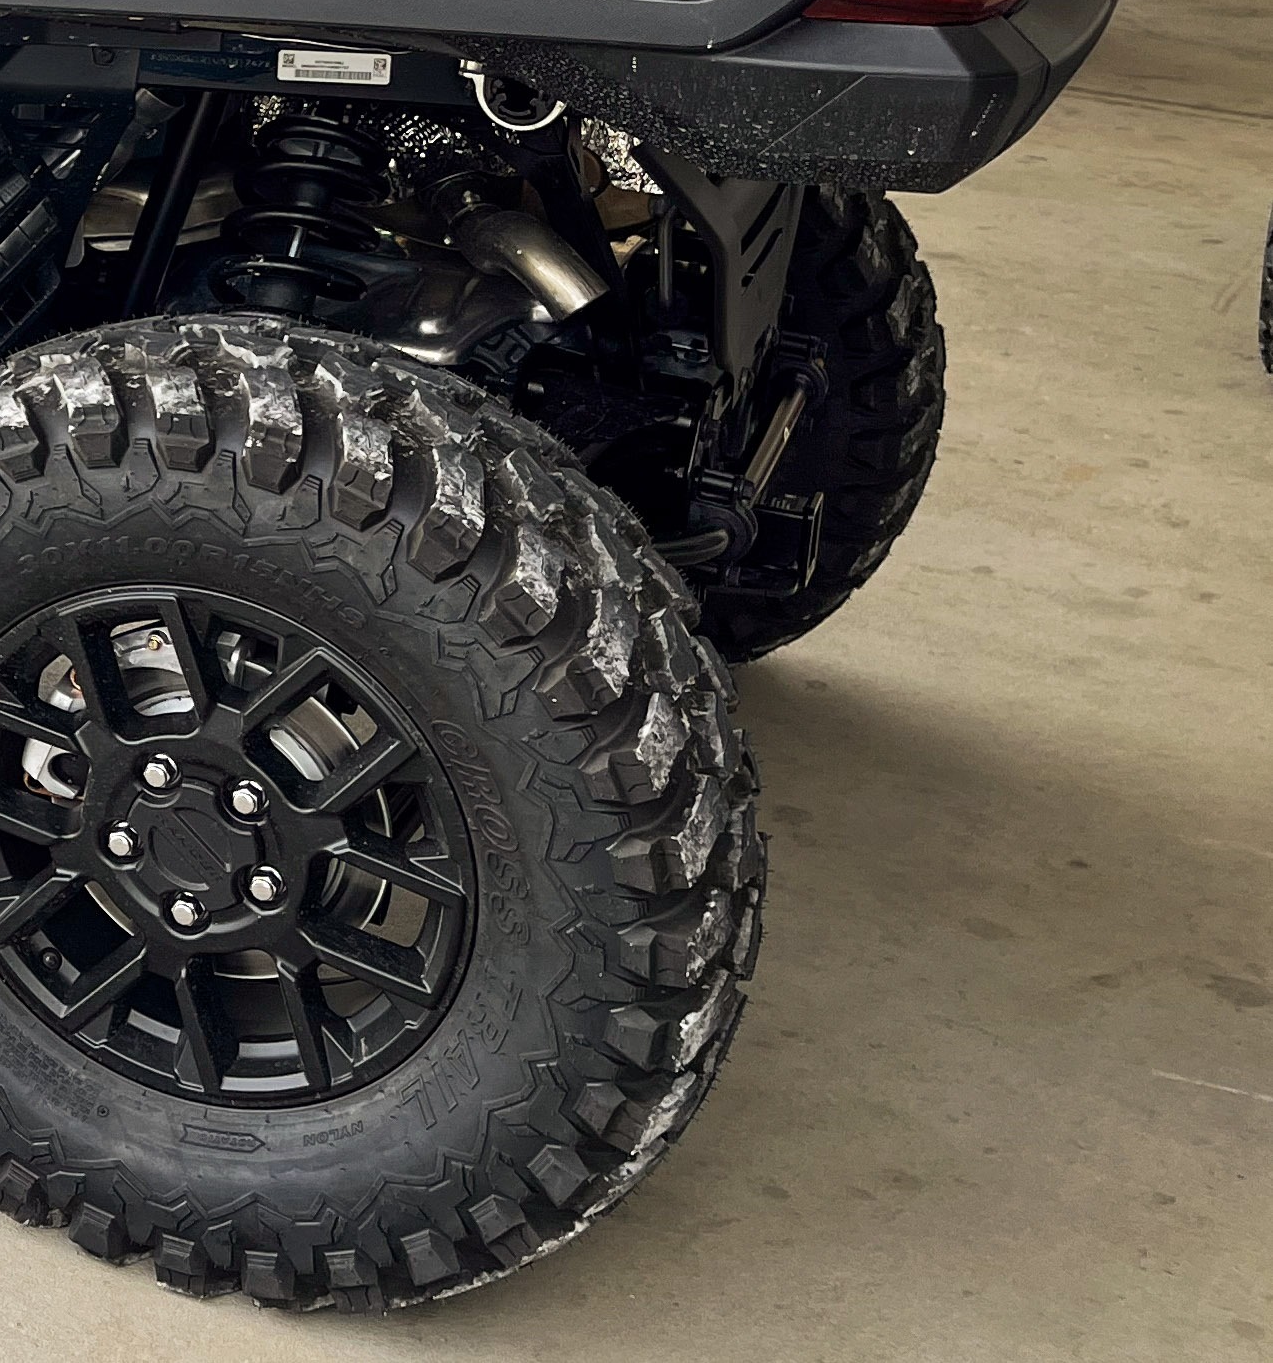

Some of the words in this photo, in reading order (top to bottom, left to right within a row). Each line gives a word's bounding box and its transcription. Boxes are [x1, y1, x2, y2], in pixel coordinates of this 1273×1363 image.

[430, 718, 533, 947] CROSS
[400, 971, 525, 1131] TRAIL
[302, 1120, 364, 1148] NYLON
